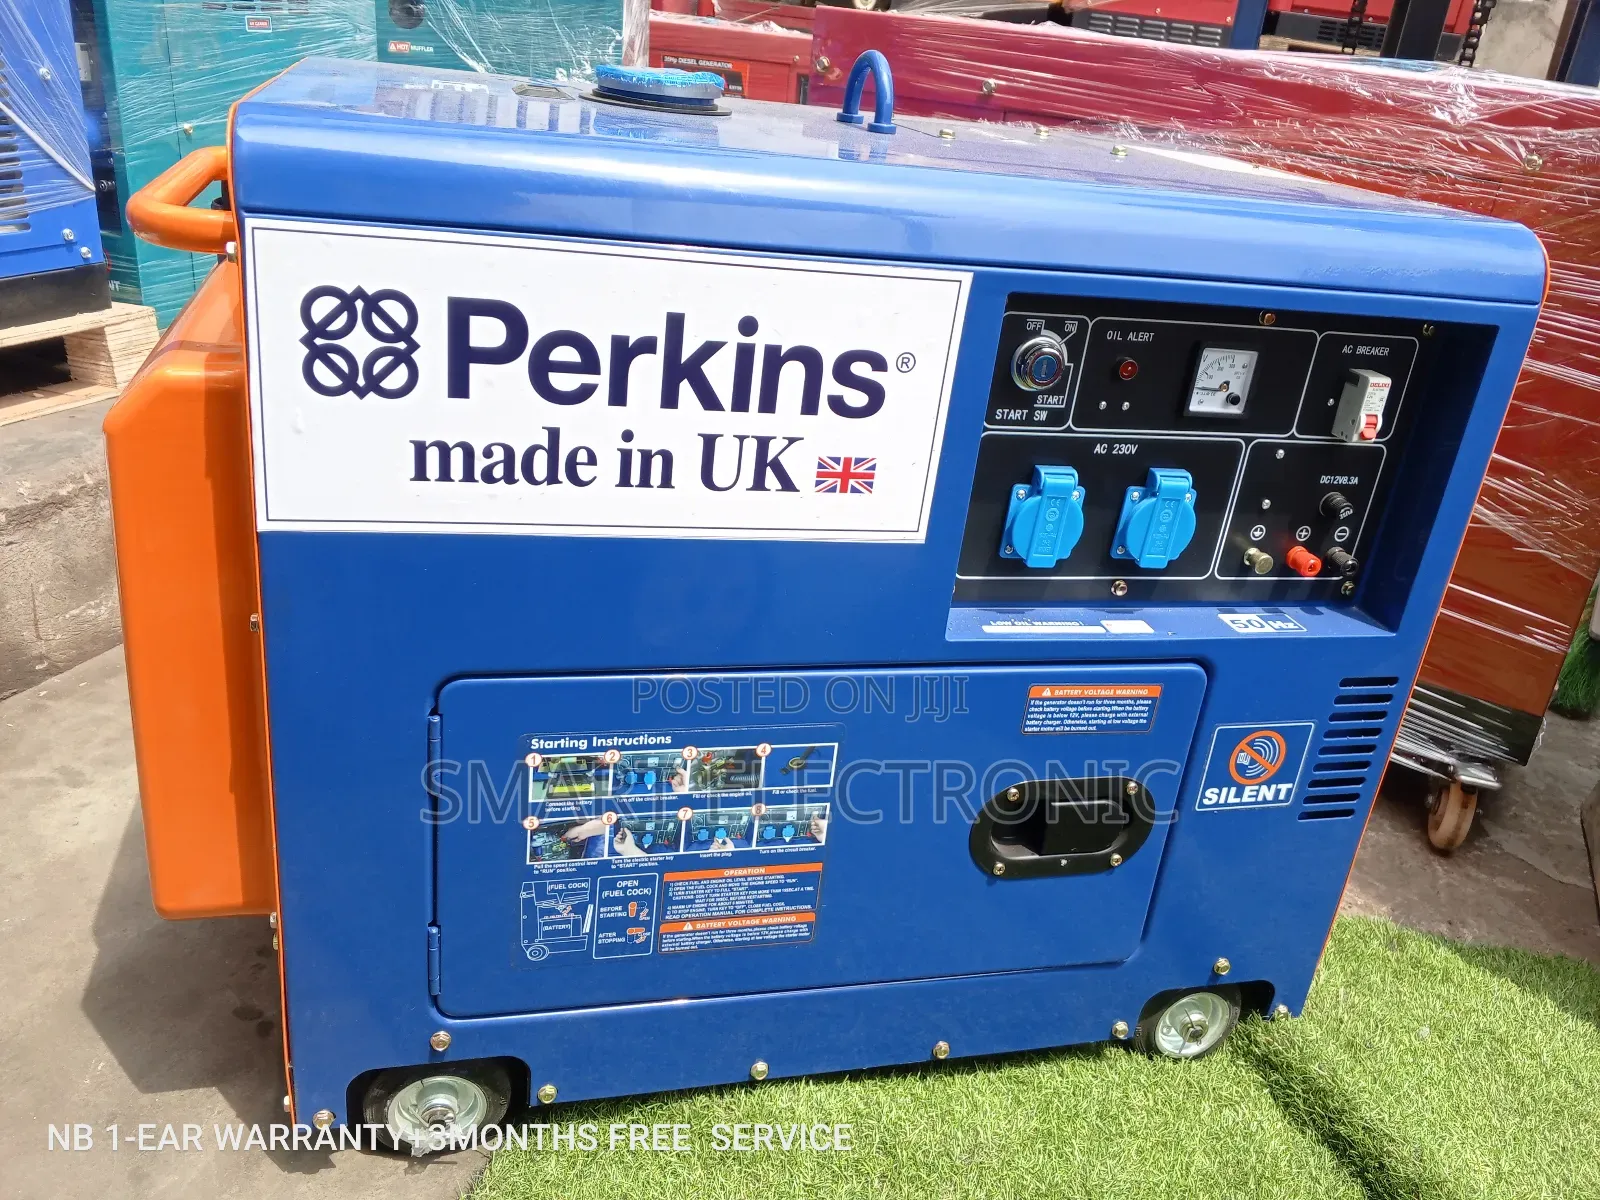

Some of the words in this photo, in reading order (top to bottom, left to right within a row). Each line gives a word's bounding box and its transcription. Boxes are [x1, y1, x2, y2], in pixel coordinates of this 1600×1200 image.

[1027, 322, 1041, 331] OFF
[1065, 323, 1076, 331] ON
[1107, 331, 1123, 340] OIL
[1128, 332, 1154, 342] ALERT
[1342, 345, 1353, 354] AC
[1356, 346, 1390, 356] BREAKER
[1036, 395, 1064, 404] START
[995, 409, 1028, 420] START
[1034, 411, 1048, 421] SW
[1094, 444, 1107, 454] AC
[1112, 444, 1138, 455] 230V
[409, 426, 598, 487] made
[614, 429, 675, 489] in
[697, 433, 806, 492] UK
[1320, 475, 1358, 485] DC12V8.3A
[1230, 619, 1264, 628] 50
[1267, 620, 1297, 629] Hz
[530, 736, 588, 750] Starting
[592, 734, 672, 747] Instructions
[687, 748, 694, 758] 3
[760, 745, 767, 755] 4
[531, 756, 537, 765] 1
[609, 751, 616, 761] 2
[1203, 783, 1293, 805] SILENT
[682, 809, 688, 819] 7
[755, 805, 762, 814] 8
[528, 818, 535, 828] 5
[606, 813, 613, 823] 6
[724, 868, 765, 876] OPERATION
[602, 890, 624, 898] (FUEL
[627, 888, 652, 896] COCK)
[760, 916, 796, 924] WARNING
